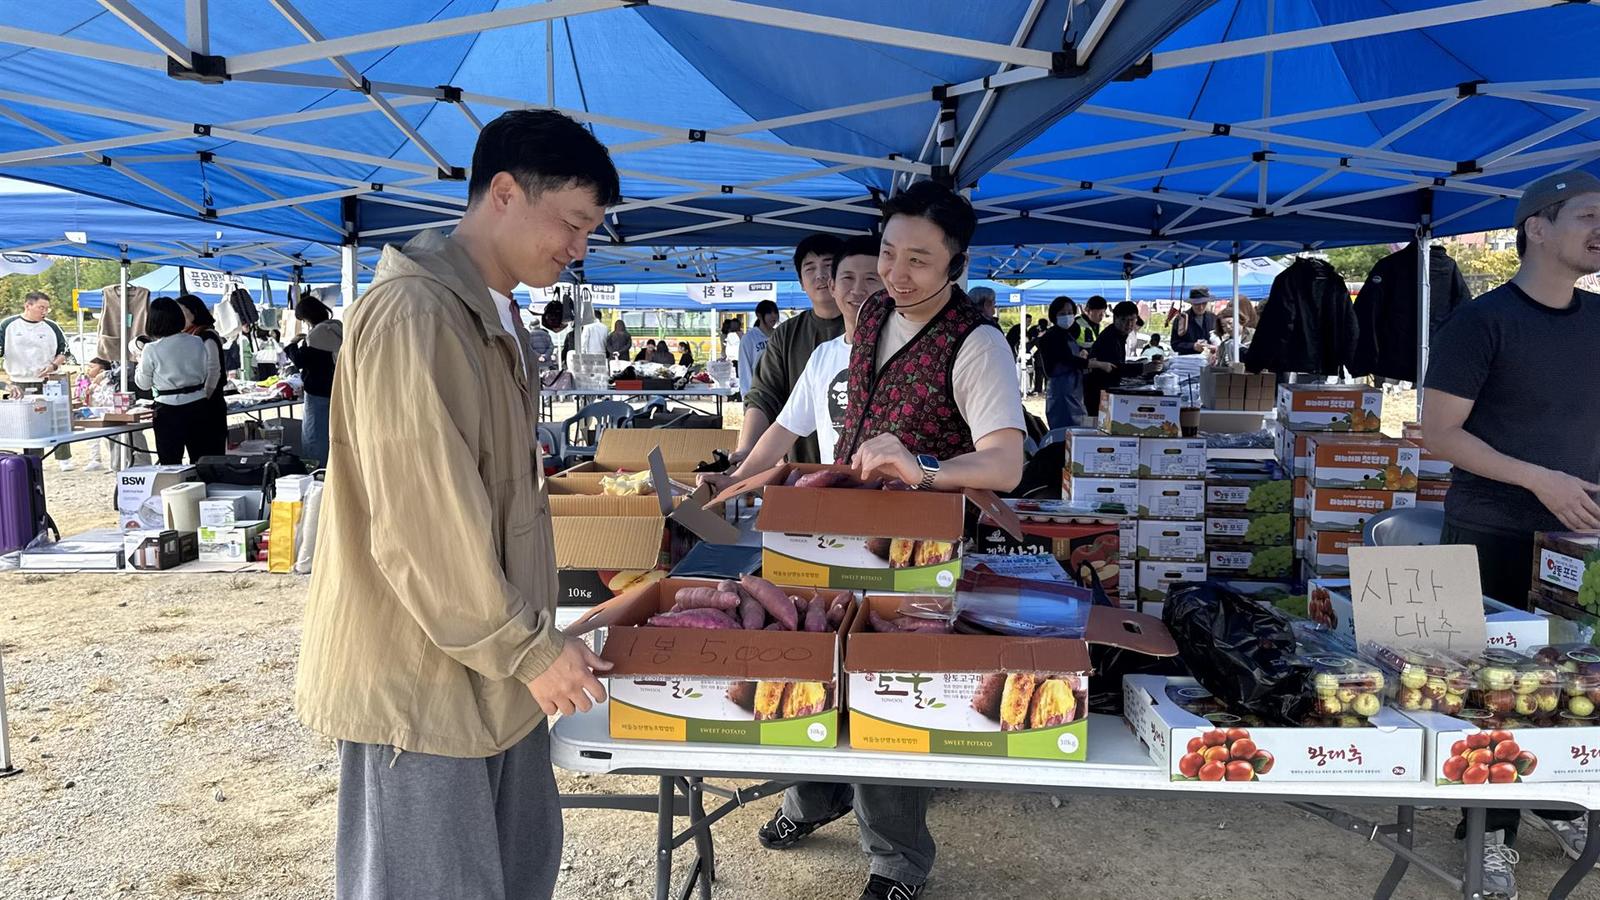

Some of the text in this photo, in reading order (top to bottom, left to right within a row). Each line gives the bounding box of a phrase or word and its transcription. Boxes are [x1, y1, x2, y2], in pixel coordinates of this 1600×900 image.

[122, 476, 146, 486] BSW
[1562, 567, 1578, 582] 포도
[1360, 567, 1444, 606] 사과
[568, 588, 592, 599] 10Kg
[1393, 609, 1462, 650] 대추
[1486, 632, 1517, 648] 대추
[943, 673, 984, 684] 황토고구마
[721, 727, 746, 735] POTATO
[966, 740, 993, 748] POTATO
[1307, 744, 1364, 767] 왕대추
